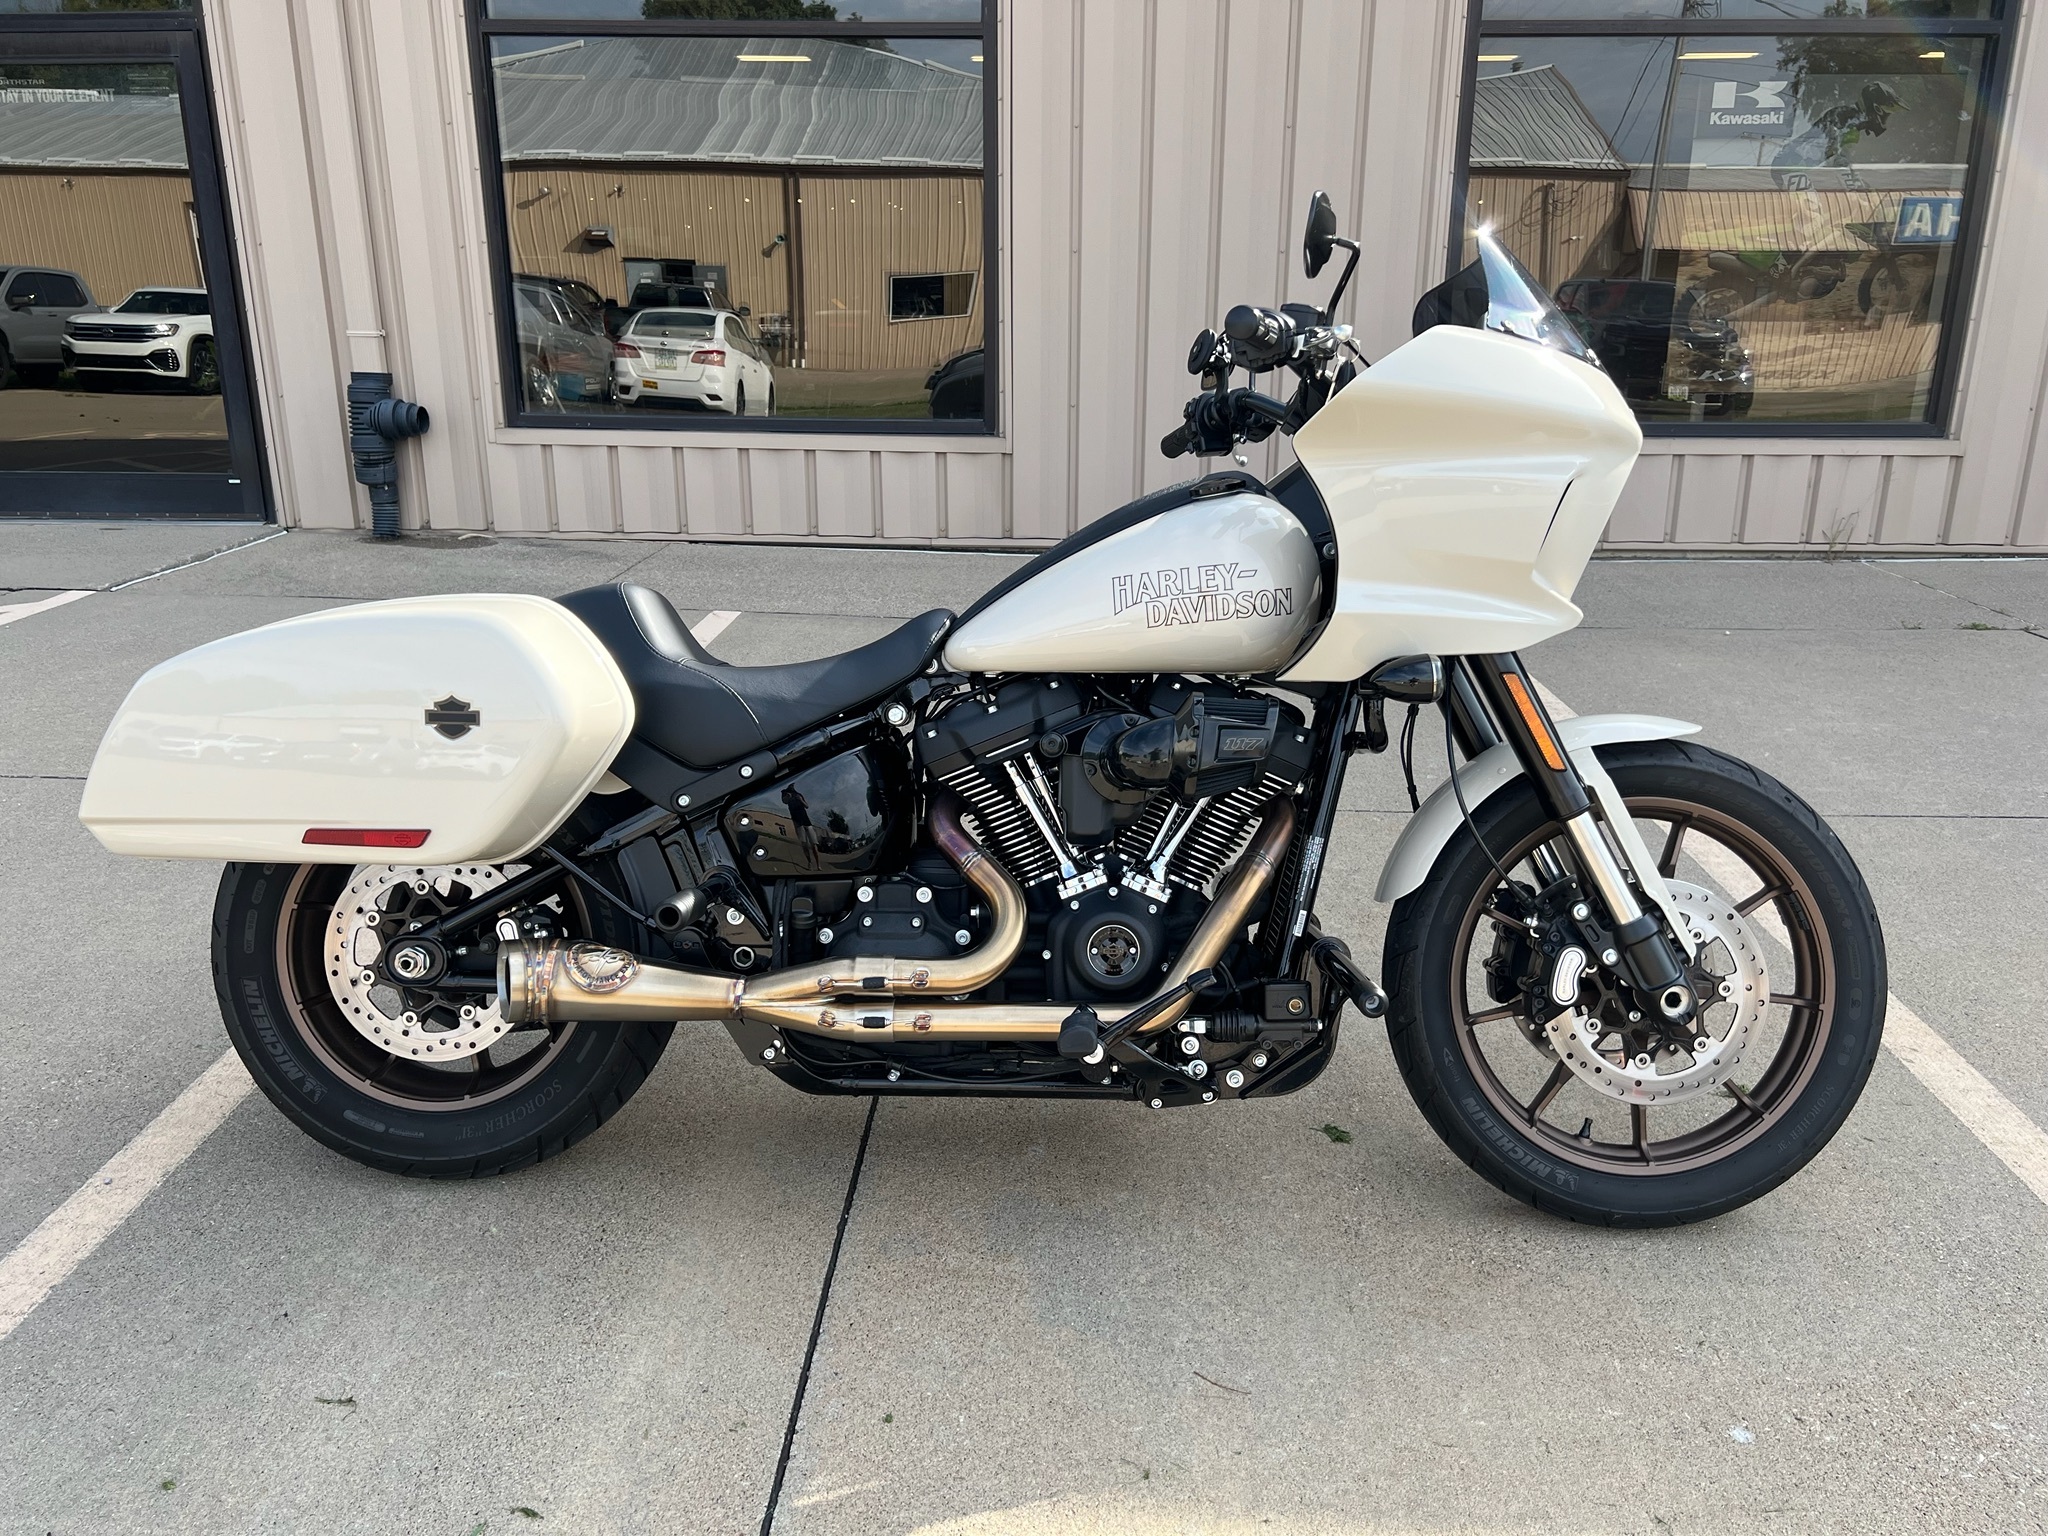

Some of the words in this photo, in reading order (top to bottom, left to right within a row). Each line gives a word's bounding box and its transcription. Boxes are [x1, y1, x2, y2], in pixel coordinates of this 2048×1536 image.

[22, 89, 35, 103] IN
[35, 89, 65, 103] YOUR
[66, 88, 116, 103] ELEMENT
[1709, 111, 1785, 125] Kawasaki
[1112, 563, 1257, 616] HARLEY-
[1146, 587, 1293, 628] DAVIDSON
[1223, 737, 1264, 751] 117
[242, 979, 302, 1083] MICHELIN
[485, 1078, 562, 1134] SCORCHER
[1791, 1084, 1835, 1141] SCORCHER
[1463, 1098, 1555, 1180] MICHELIN
